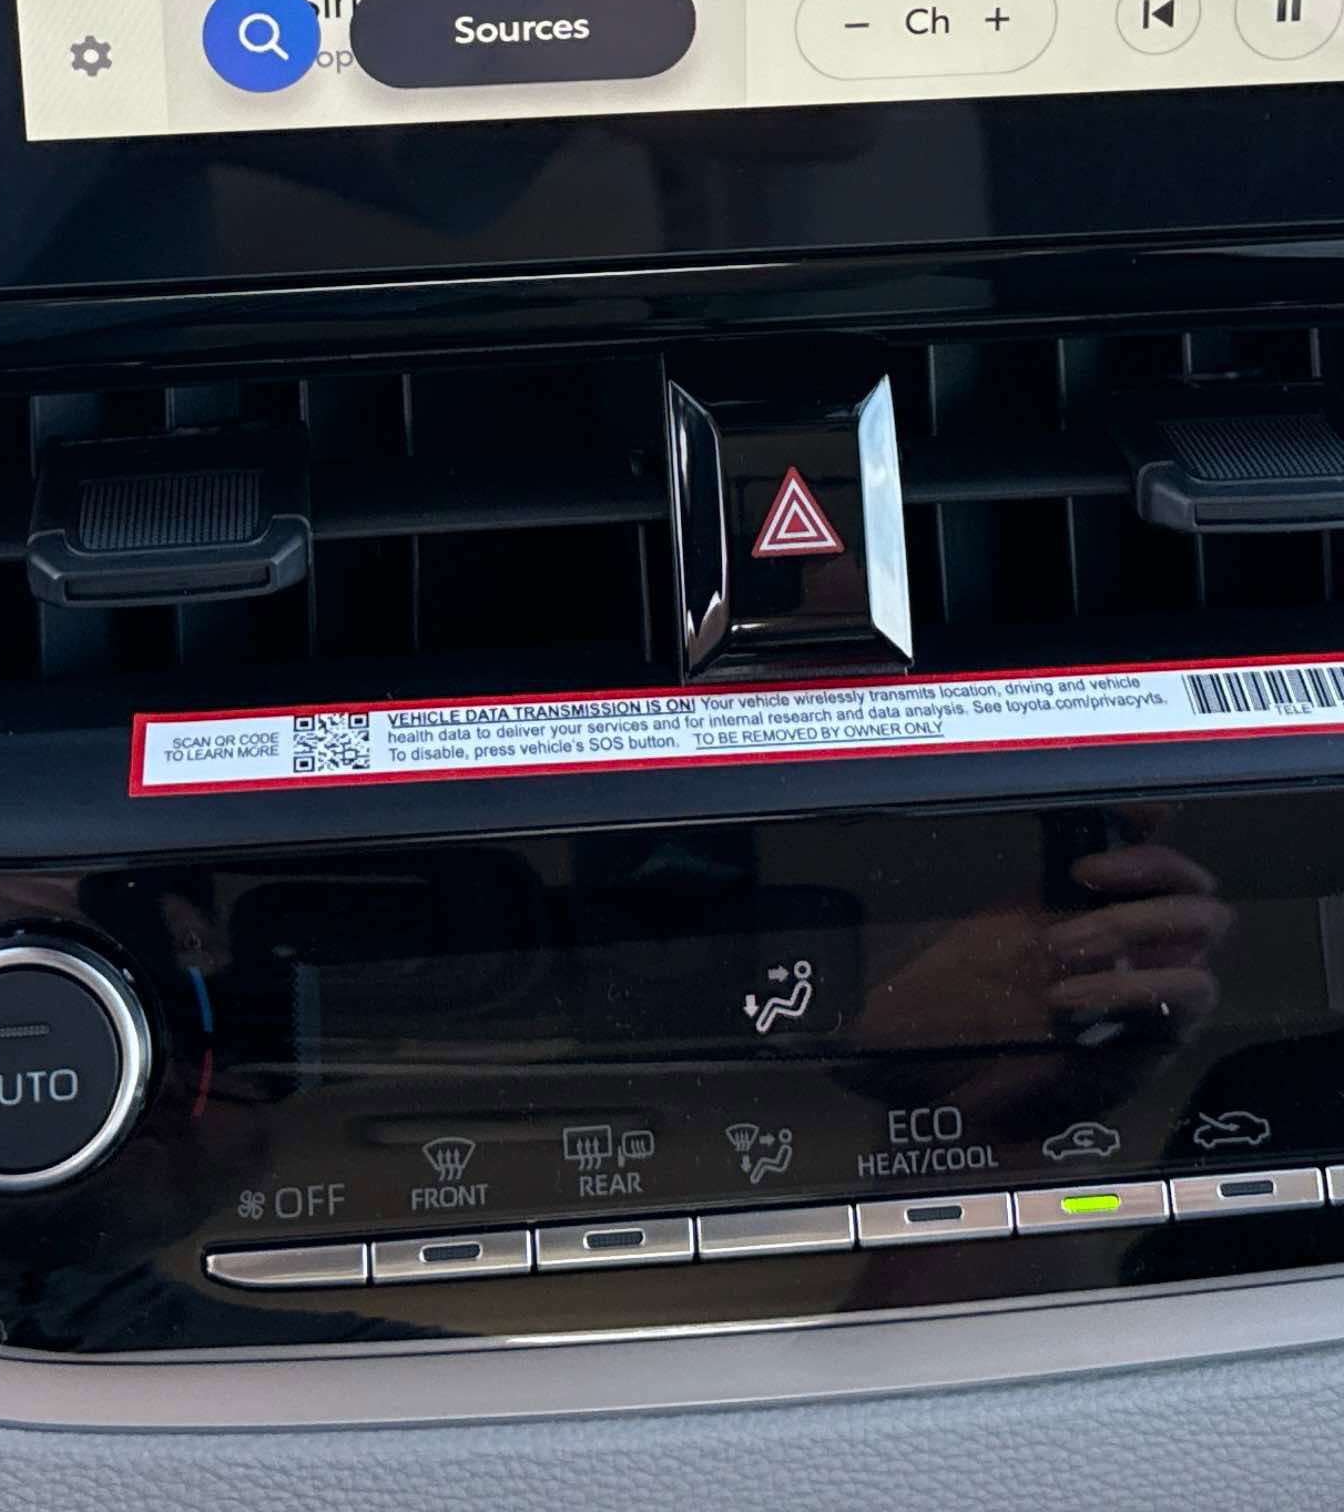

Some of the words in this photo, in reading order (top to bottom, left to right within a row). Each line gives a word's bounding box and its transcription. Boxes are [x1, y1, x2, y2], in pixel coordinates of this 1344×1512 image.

[454, 15, 590, 45] Sources
[905, 5, 950, 36] Ch
[387, 709, 460, 726] VEHICLE
[465, 706, 509, 723] DATA
[515, 701, 641, 721] TRANSMISSION
[647, 699, 661, 713] IS
[700, 696, 733, 711] Your
[738, 693, 790, 708] vehicle
[794, 690, 864, 706] wirelessly
[870, 686, 936, 702] transmits
[939, 683, 1002, 700] location,
[1006, 680, 1053, 696] driving
[1059, 678, 1085, 693] and
[1089, 676, 1141, 691] vehicle
[1275, 703, 1312, 716] TELE
[387, 729, 433, 744] health
[438, 728, 470, 742] data
[476, 726, 491, 739] to
[496, 724, 546, 738] deliver
[550, 722, 583, 739] your
[587, 718, 648, 733] services
[653, 716, 680, 730] and
[685, 715, 705, 728] for
[709, 711, 763, 727] internal
[767, 709, 832, 725] research
[836, 706, 864, 721] and
[868, 704, 900, 719] data
[972, 700, 1002, 714] See
[164, 749, 184, 762] TO
[187, 747, 233, 761] LEARN
[237, 744, 279, 758] MORE
[172, 735, 211, 749] SCAN
[239, 731, 279, 746] CODE
[388, 747, 406, 762] To
[411, 744, 469, 761] disable,
[474, 743, 515, 761] press
[520, 738, 584, 755] vehicle's
[589, 737, 624, 752] SOS
[629, 734, 680, 749] button.
[694, 732, 714, 745] TO
[719, 730, 738, 744] BE
[743, 726, 817, 743] REMOVED
[821, 726, 841, 739] BY
[844, 722, 901, 737] OWNER
[905, 720, 943, 735] ONLY
[888, 1105, 962, 1145] ECO
[858, 1143, 999, 1177] HEAT/COOL
[411, 1183, 487, 1211] FRONT
[579, 1172, 642, 1197] REAR
[275, 1183, 344, 1220] OFF
